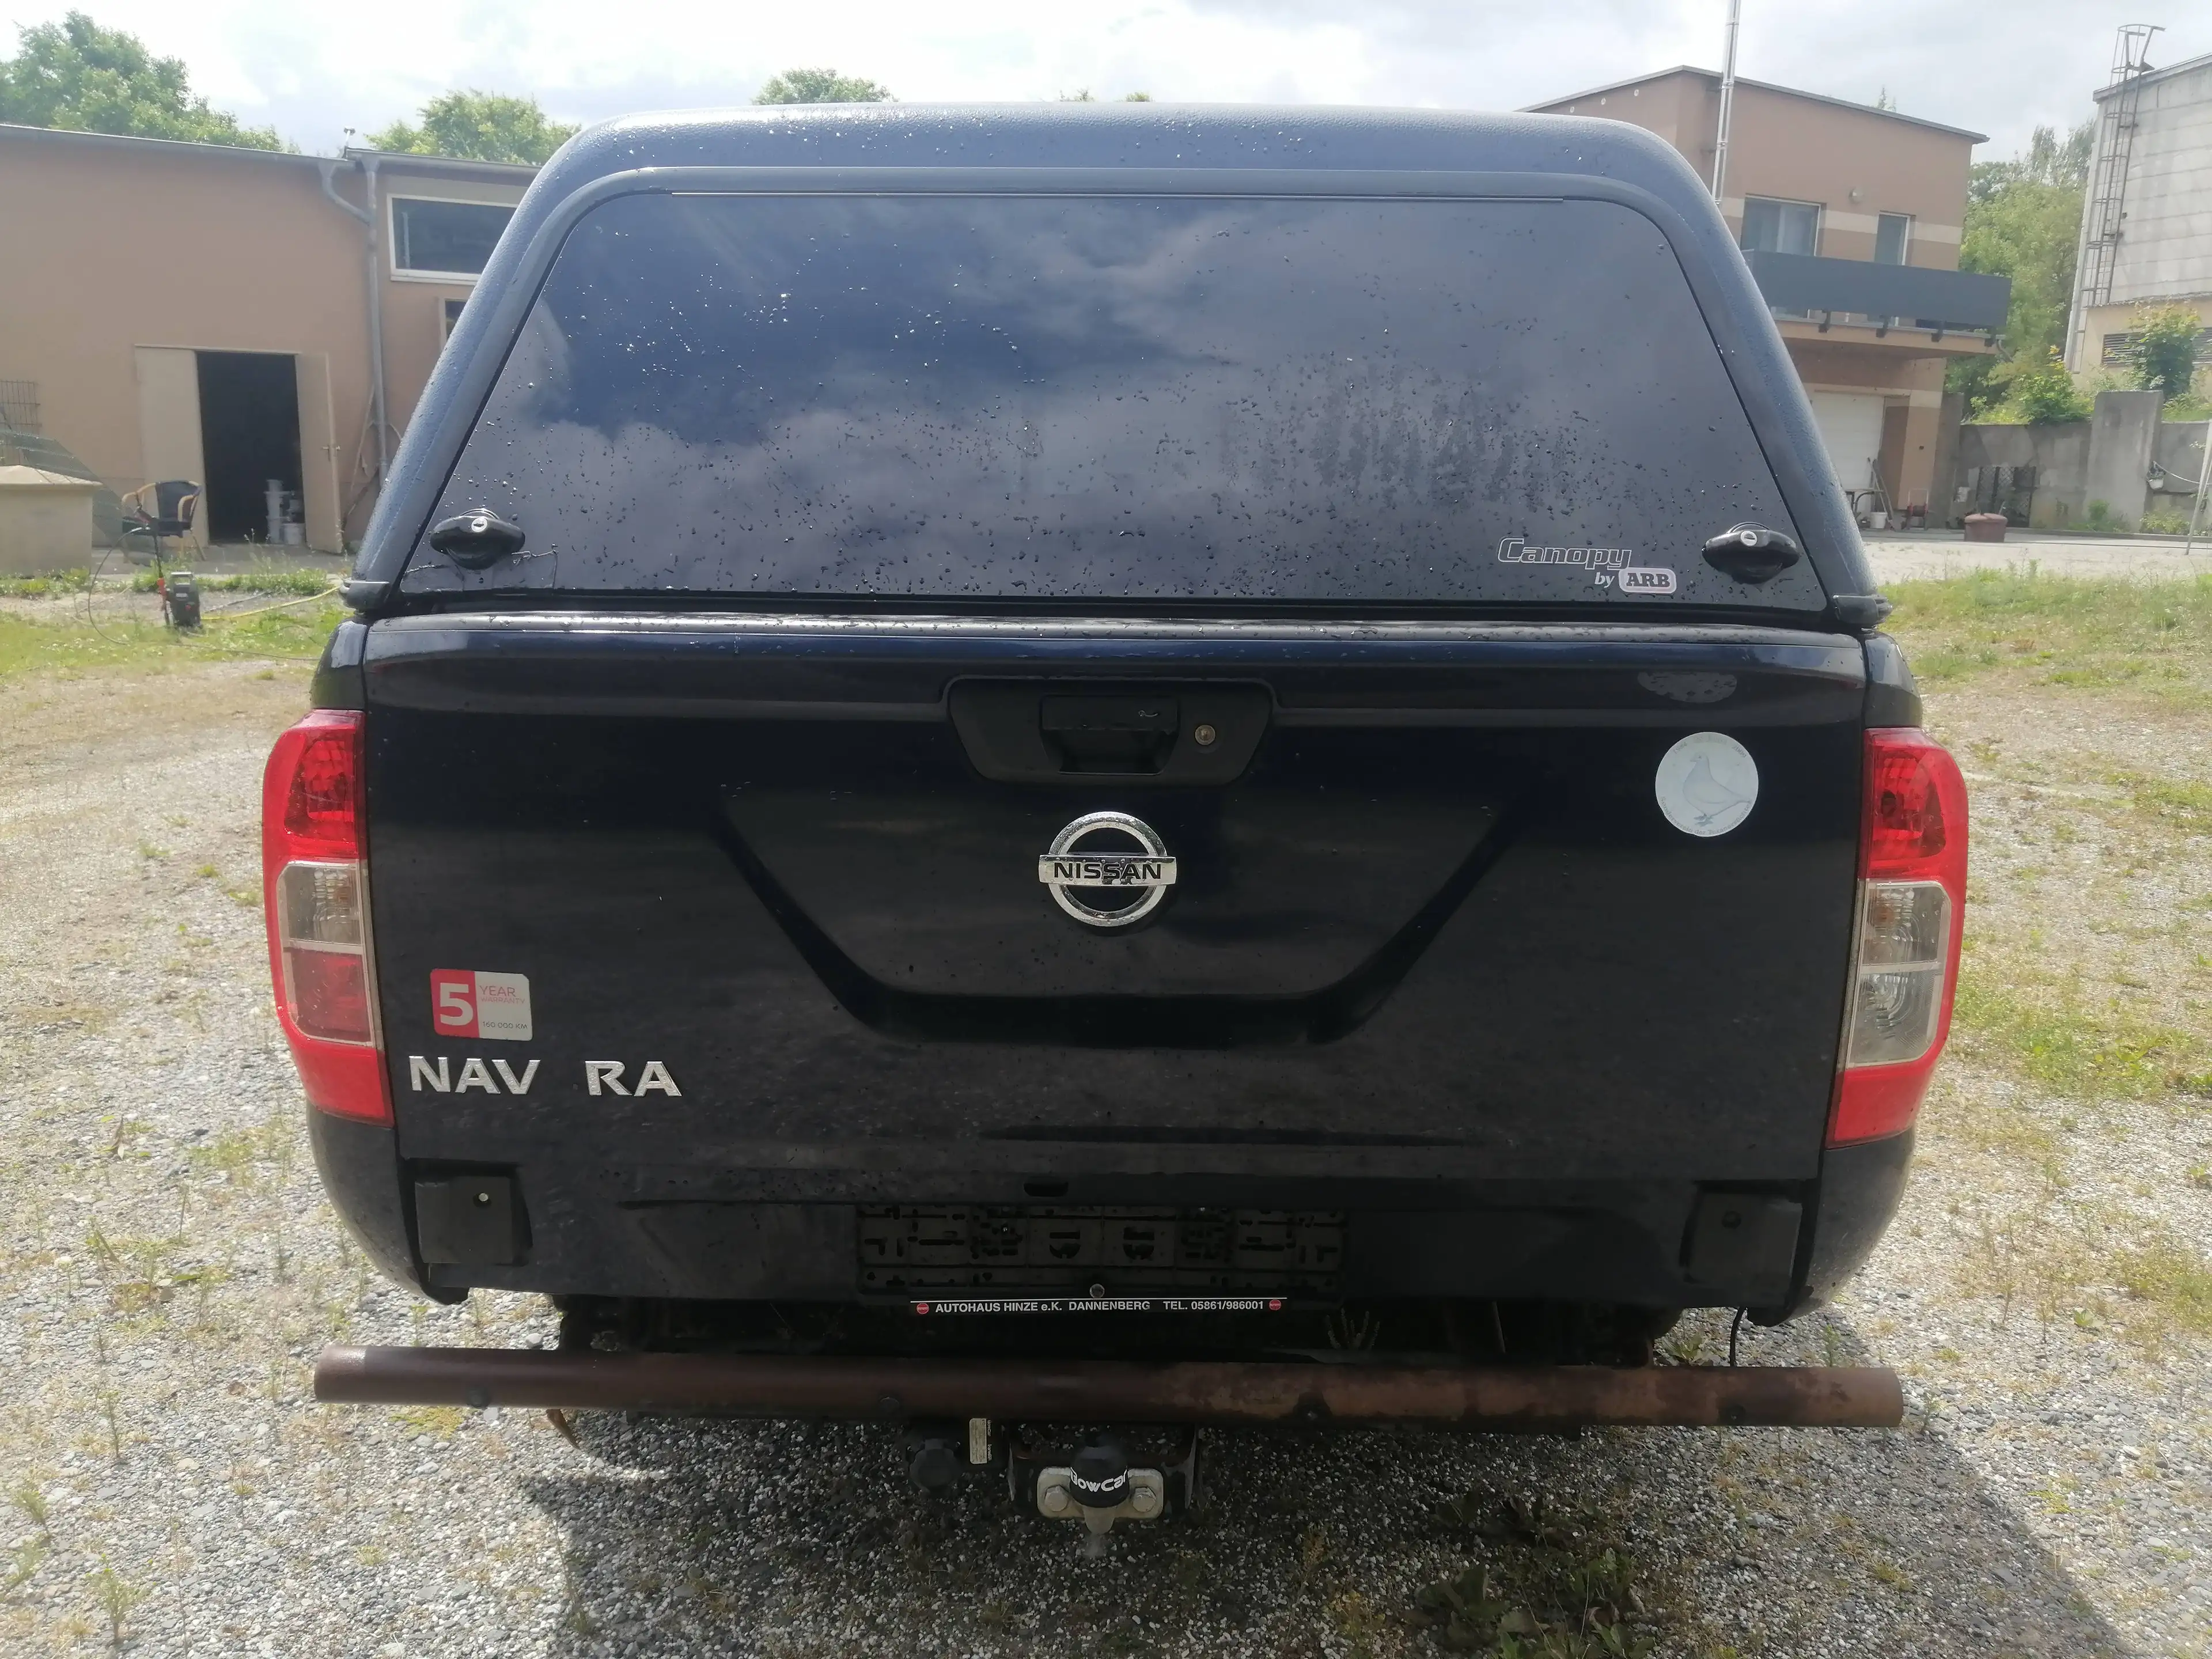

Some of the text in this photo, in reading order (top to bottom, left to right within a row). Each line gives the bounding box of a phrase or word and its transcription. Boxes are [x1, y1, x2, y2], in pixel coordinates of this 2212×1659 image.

[1498, 537, 1631, 570] Canopy
[1594, 572, 1670, 588] by ARB
[1054, 862, 1161, 880] NISSAN
[479, 985, 516, 997] YEAR
[440, 982, 474, 1026] 5
[935, 1302, 1001, 1313] AUTOHAUS
[1003, 1302, 1038, 1312] HINZE
[1041, 1302, 1062, 1311] e.K.
[1069, 1301, 1150, 1310] DANNENBERG
[1162, 1301, 1188, 1310] TEL.
[1191, 1301, 1264, 1310] 05861/986001
